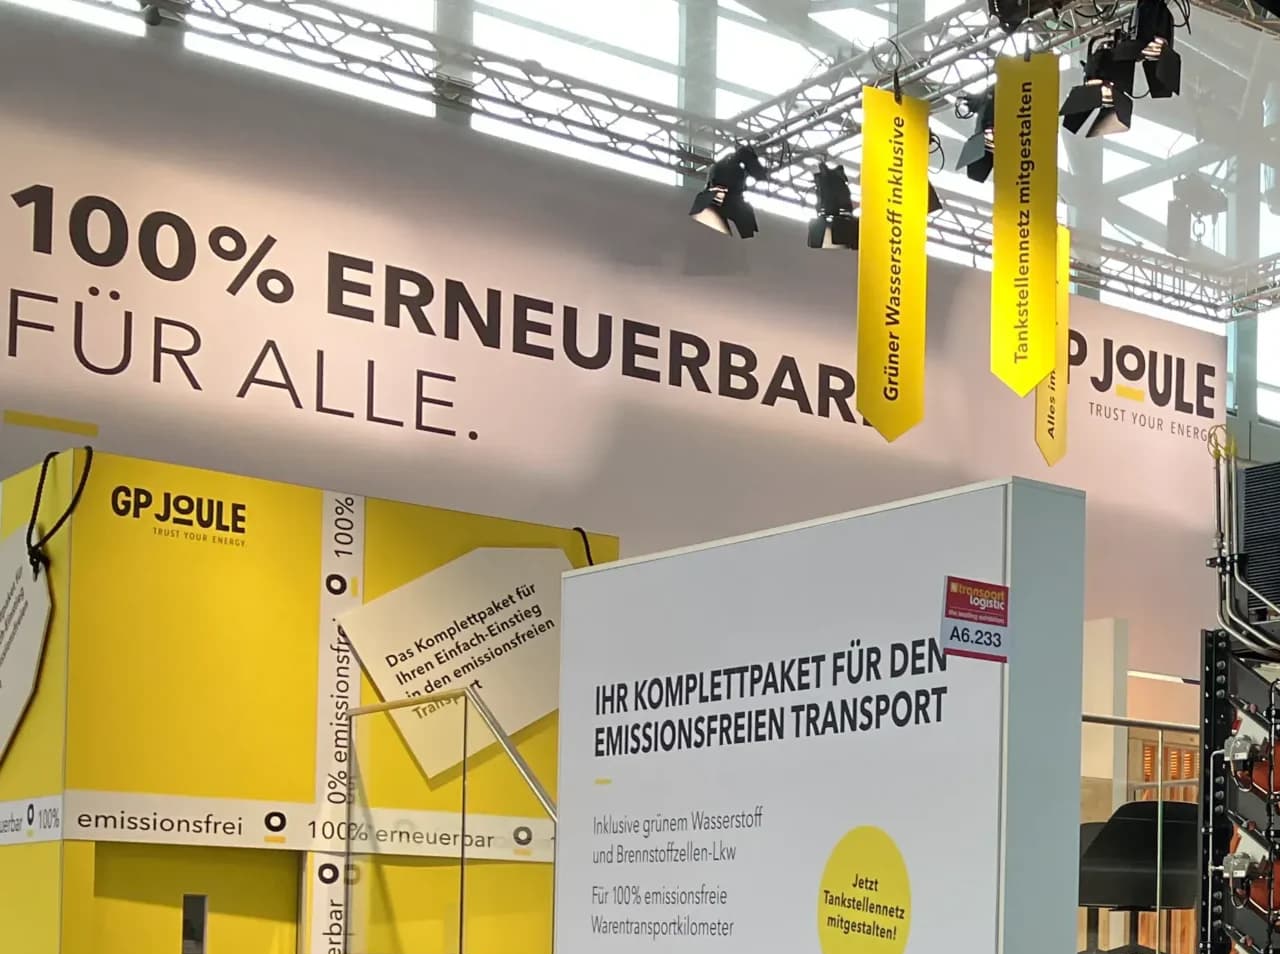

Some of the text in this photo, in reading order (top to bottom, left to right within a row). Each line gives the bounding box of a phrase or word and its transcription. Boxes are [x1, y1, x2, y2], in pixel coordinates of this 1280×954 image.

[1013, 81, 1035, 364] Tankstellennetz mitgestalten
[883, 116, 905, 402] Grüner Wasserstoff inklusive
[10, 184, 873, 427] 100% ERNEUERBAR
[7, 286, 478, 441] FÜR ALLE.
[1068, 328, 1216, 419] P JOULE
[1047, 369, 1057, 440] Alles im
[1089, 402, 1210, 443] TRUST YOUR ENERG
[111, 485, 246, 533] GP JOULE
[334, 496, 354, 558] 100%
[153, 527, 179, 538] TRUST
[184, 532, 207, 542] YOUR
[385, 583, 536, 668] Das Komplettpaket für
[970, 595, 1005, 610] logistic
[396, 604, 542, 685] Ihren Einfach-Einstieg
[424, 675, 452, 694] den
[453, 618, 556, 678] emissionsfreien
[949, 626, 1002, 647] A6.233
[329, 618, 350, 763] emissionsfr
[595, 637, 948, 716] IHR KOMPLETTPAKET FÜR DEN
[594, 686, 948, 757] EMISSIONSFREIEN TRANSPORT
[0, 812, 22, 833] uerbar
[38, 808, 60, 829] 100%
[78, 811, 243, 835] emissionsfrei
[308, 820, 368, 841] 100%
[376, 829, 494, 848] erneuerbar
[593, 805, 763, 838] Inklusive grünem Wasserstoff
[593, 840, 737, 864] und Brennstoffzellen-Lkw
[592, 883, 728, 905] Für 100% emissionsfreie
[824, 889, 905, 920] Tankstellennetz
[852, 873, 879, 892] Jetzt
[591, 914, 734, 941] Warentransportkilometer
[827, 914, 897, 941] mitgestalten!
